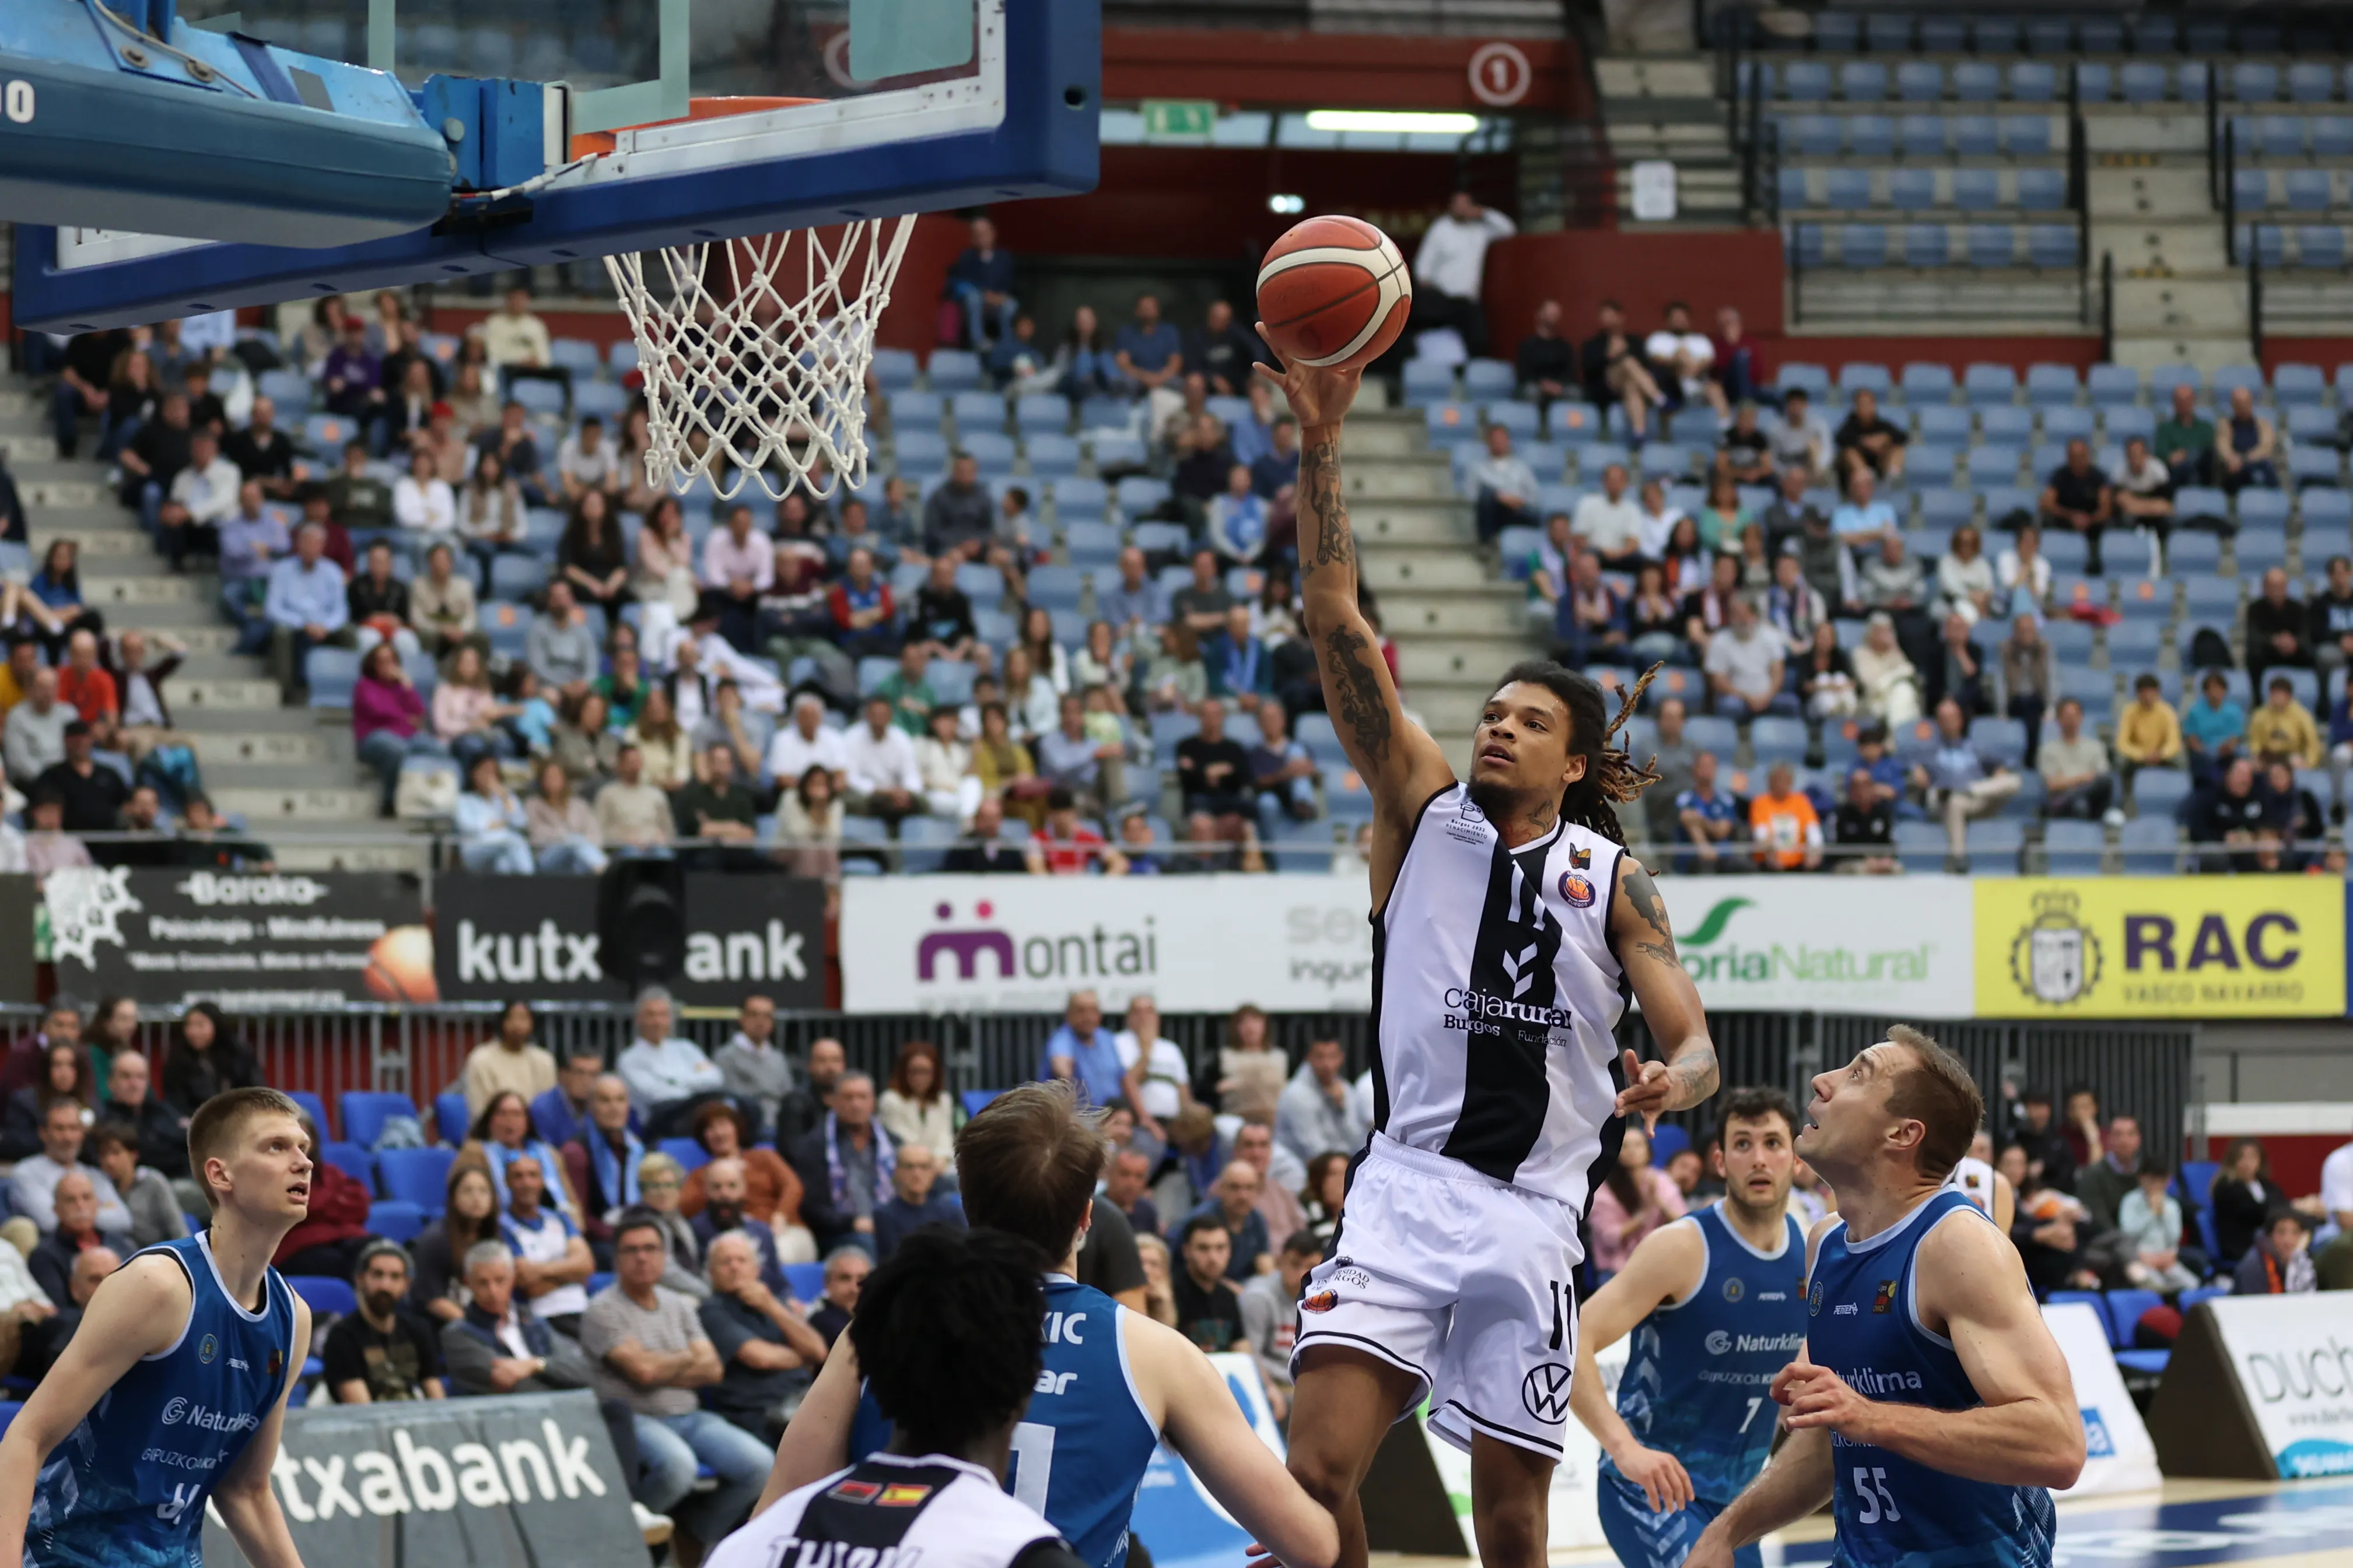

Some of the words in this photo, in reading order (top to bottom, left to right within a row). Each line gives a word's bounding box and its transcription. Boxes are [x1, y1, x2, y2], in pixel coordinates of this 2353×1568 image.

[1489, 58, 1508, 91] 1
[0, 79, 35, 124] 0
[1445, 823, 1487, 839] RENACIMIENTO
[1567, 898, 1588, 907] BURGOS
[2124, 912, 2301, 973] RAC
[1444, 988, 1572, 1031] Cajarural
[1444, 1014, 1501, 1037] Burgos
[1518, 1030, 1567, 1047] Fundación
[1549, 1280, 1573, 1356] 11
[1738, 1397, 1763, 1434] 7
[1853, 1467, 1901, 1524] 55
